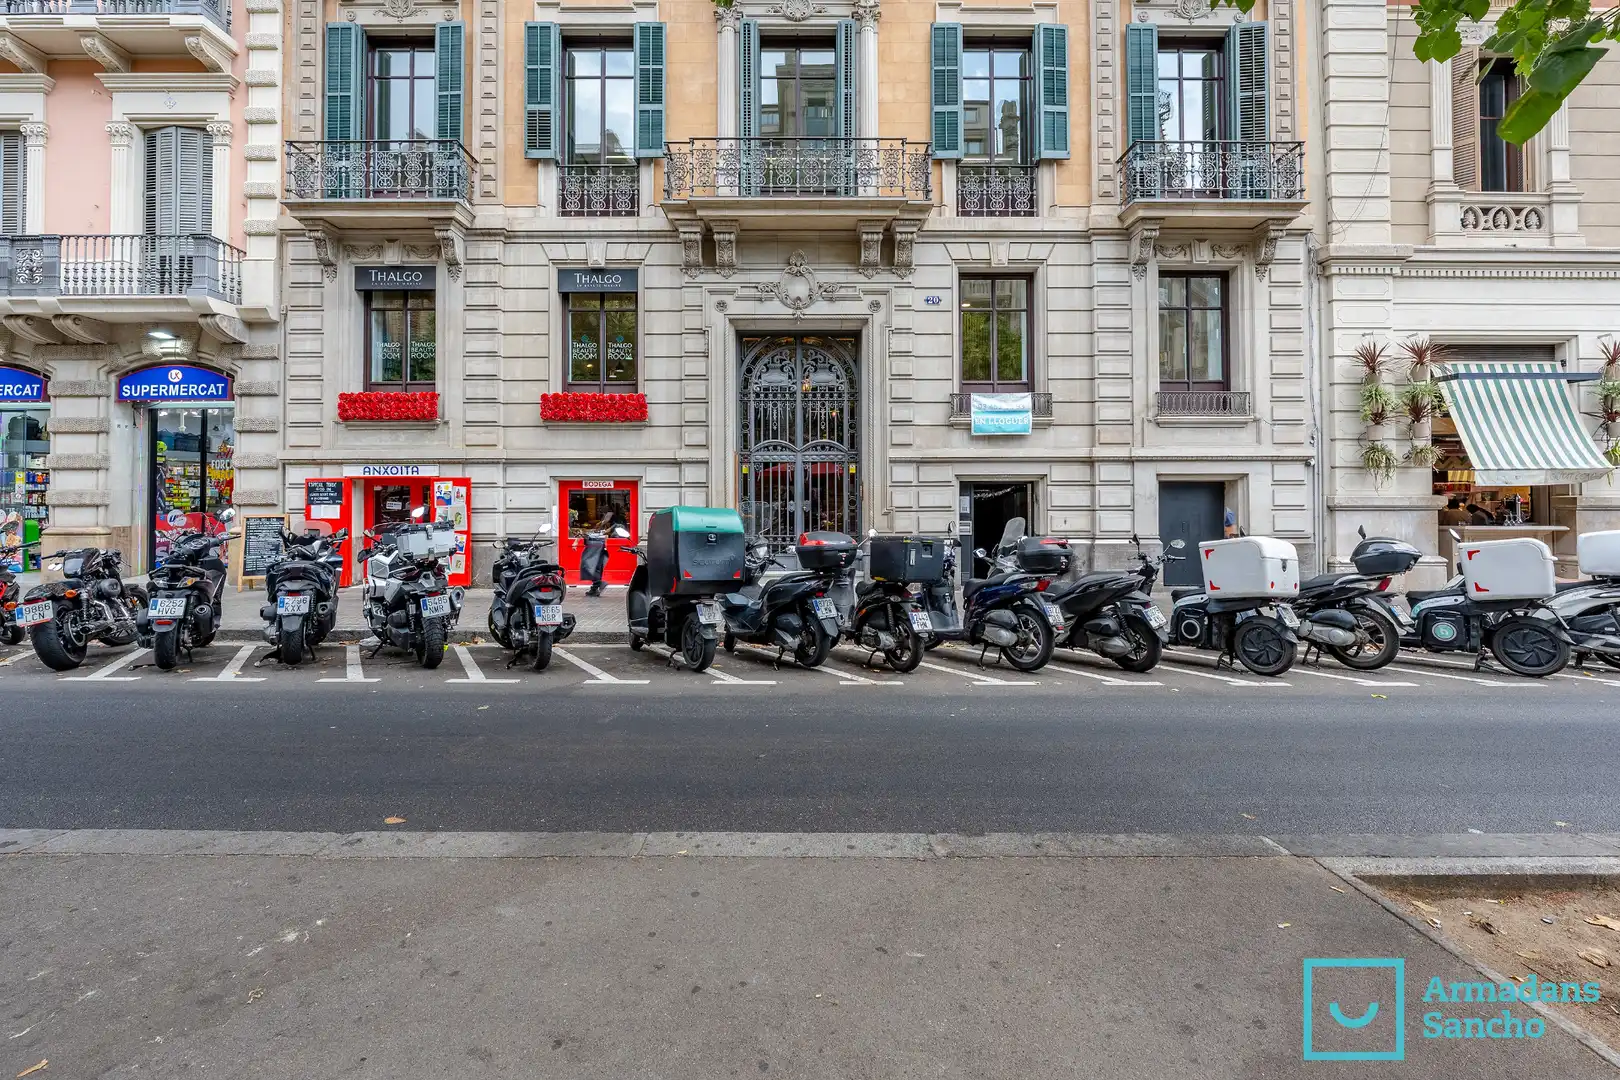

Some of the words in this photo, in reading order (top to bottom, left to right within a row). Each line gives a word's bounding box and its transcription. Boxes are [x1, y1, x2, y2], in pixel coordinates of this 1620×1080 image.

[369, 269, 422, 282] THALGO
[574, 272, 622, 284] THALGO
[927, 296, 939, 304] 20
[122, 384, 225, 397] SUPERMERCAT
[988, 416, 1029, 424] LLOGUER
[362, 466, 420, 476] ANXOITA
[24, 603, 50, 614] 9866
[428, 605, 444, 614] NMR
[25, 612, 45, 622] LCN
